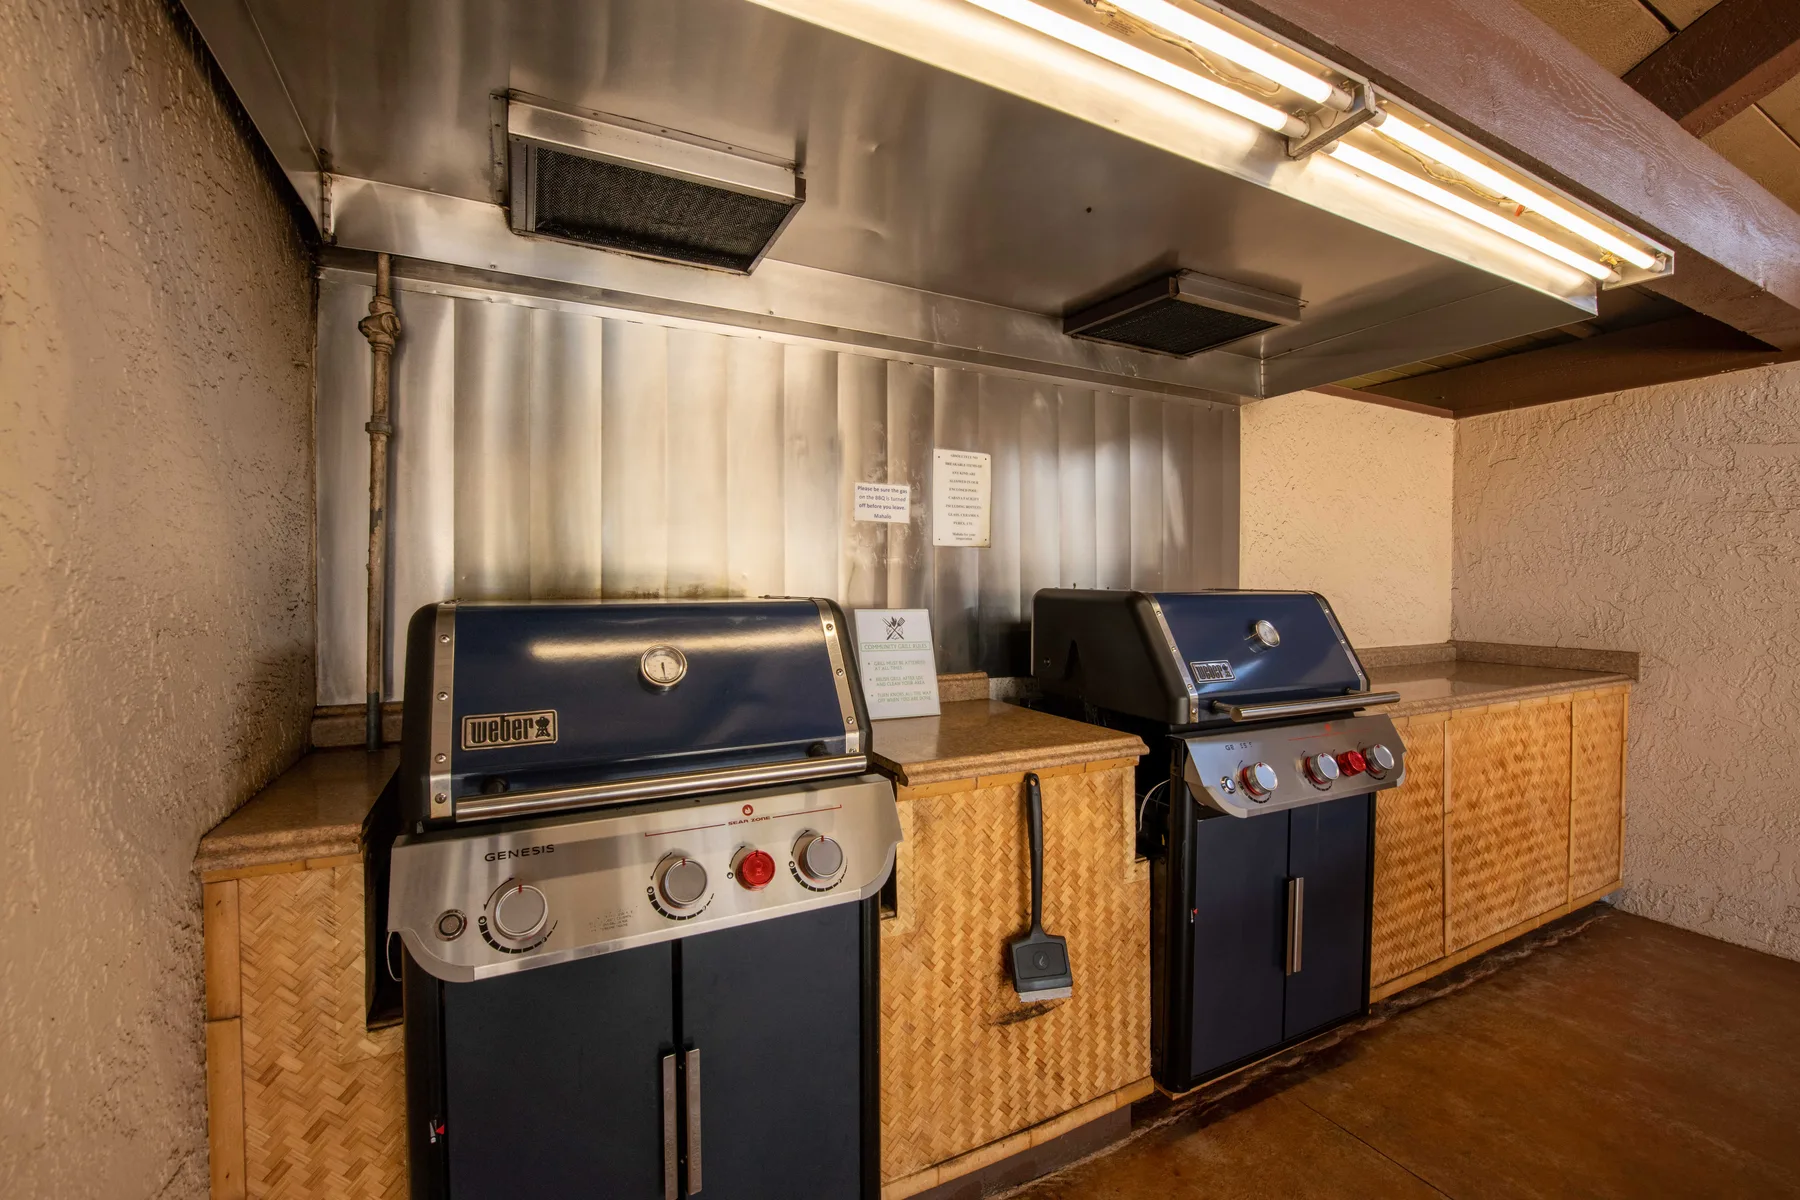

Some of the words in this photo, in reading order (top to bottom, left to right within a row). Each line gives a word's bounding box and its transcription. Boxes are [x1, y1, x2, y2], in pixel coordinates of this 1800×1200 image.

[1195, 663, 1224, 680] weber
[470, 715, 534, 744] weber
[484, 844, 555, 862] GENESIS
